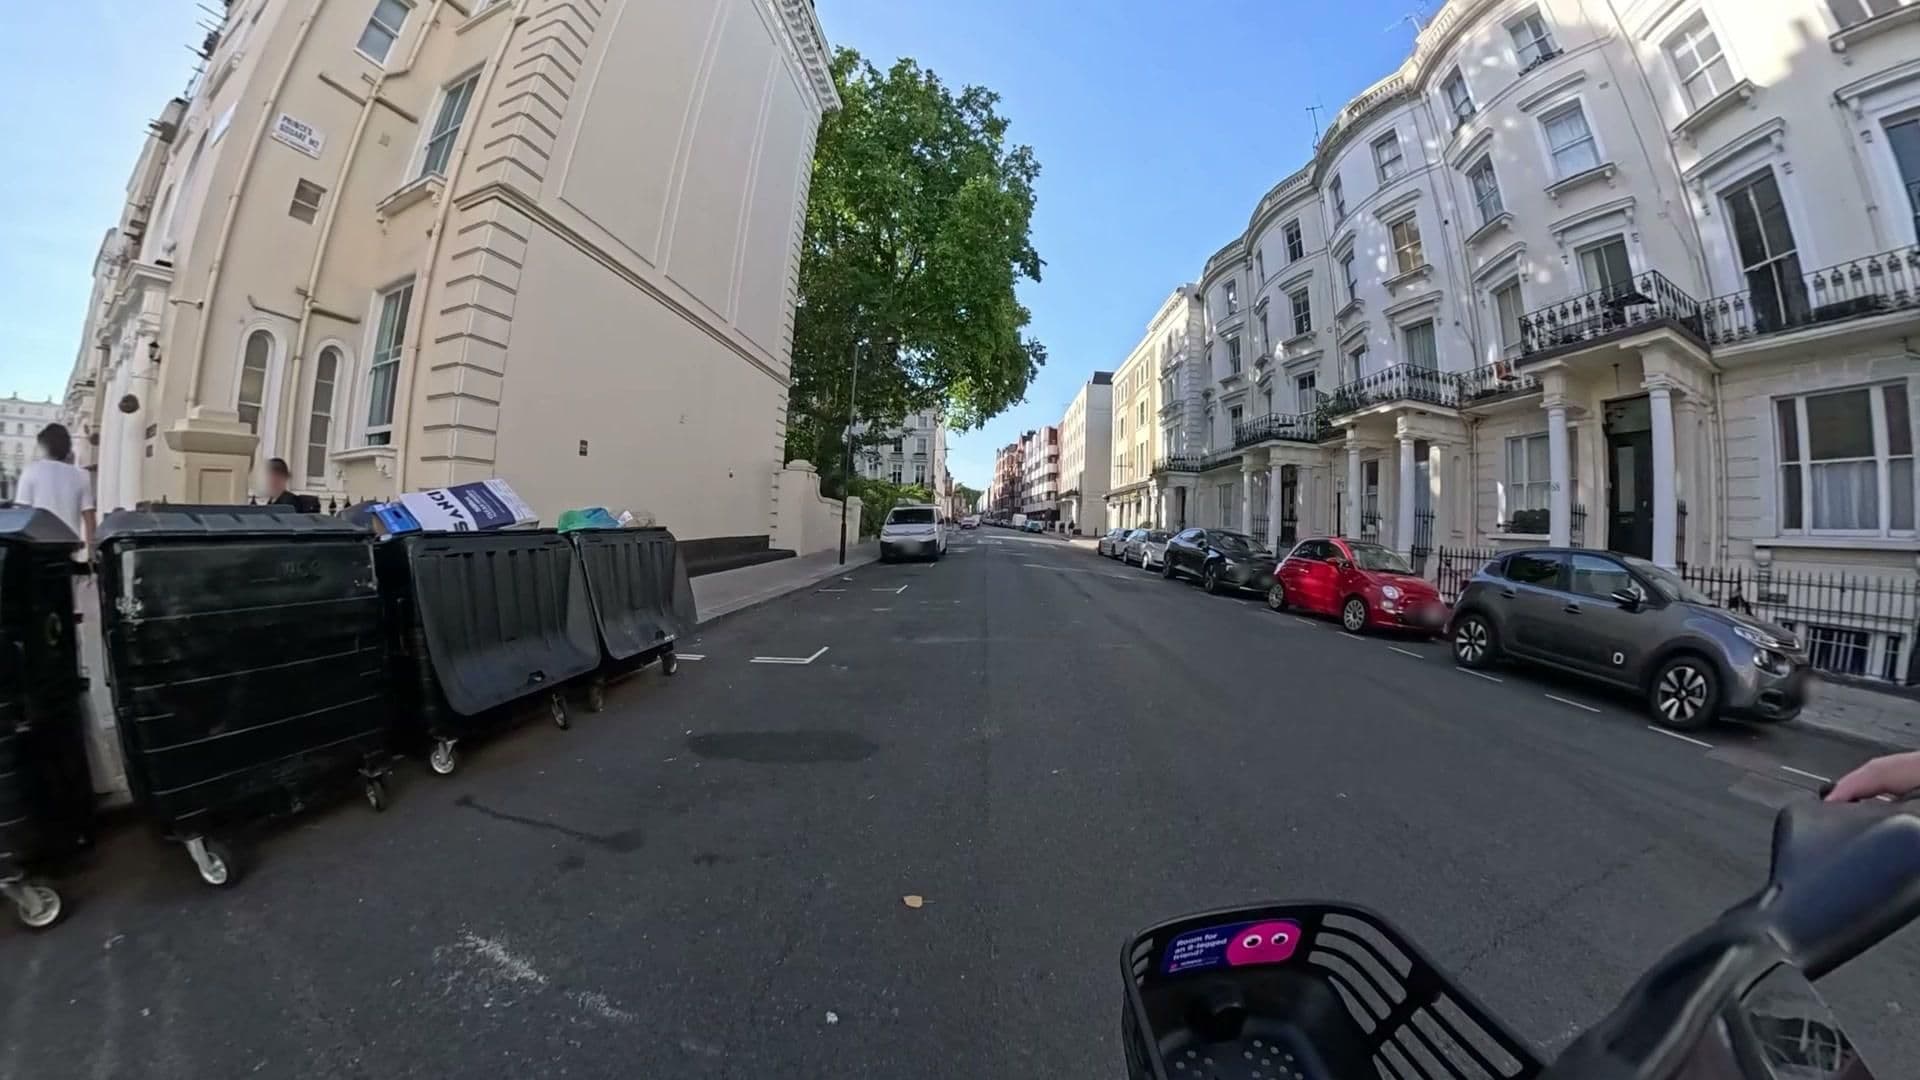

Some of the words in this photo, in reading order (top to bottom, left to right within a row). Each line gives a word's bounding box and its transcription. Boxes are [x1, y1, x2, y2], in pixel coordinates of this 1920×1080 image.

[1177, 936, 1202, 946] Room
[1204, 933, 1218, 941] for
[1173, 948, 1204, 960] friend?
